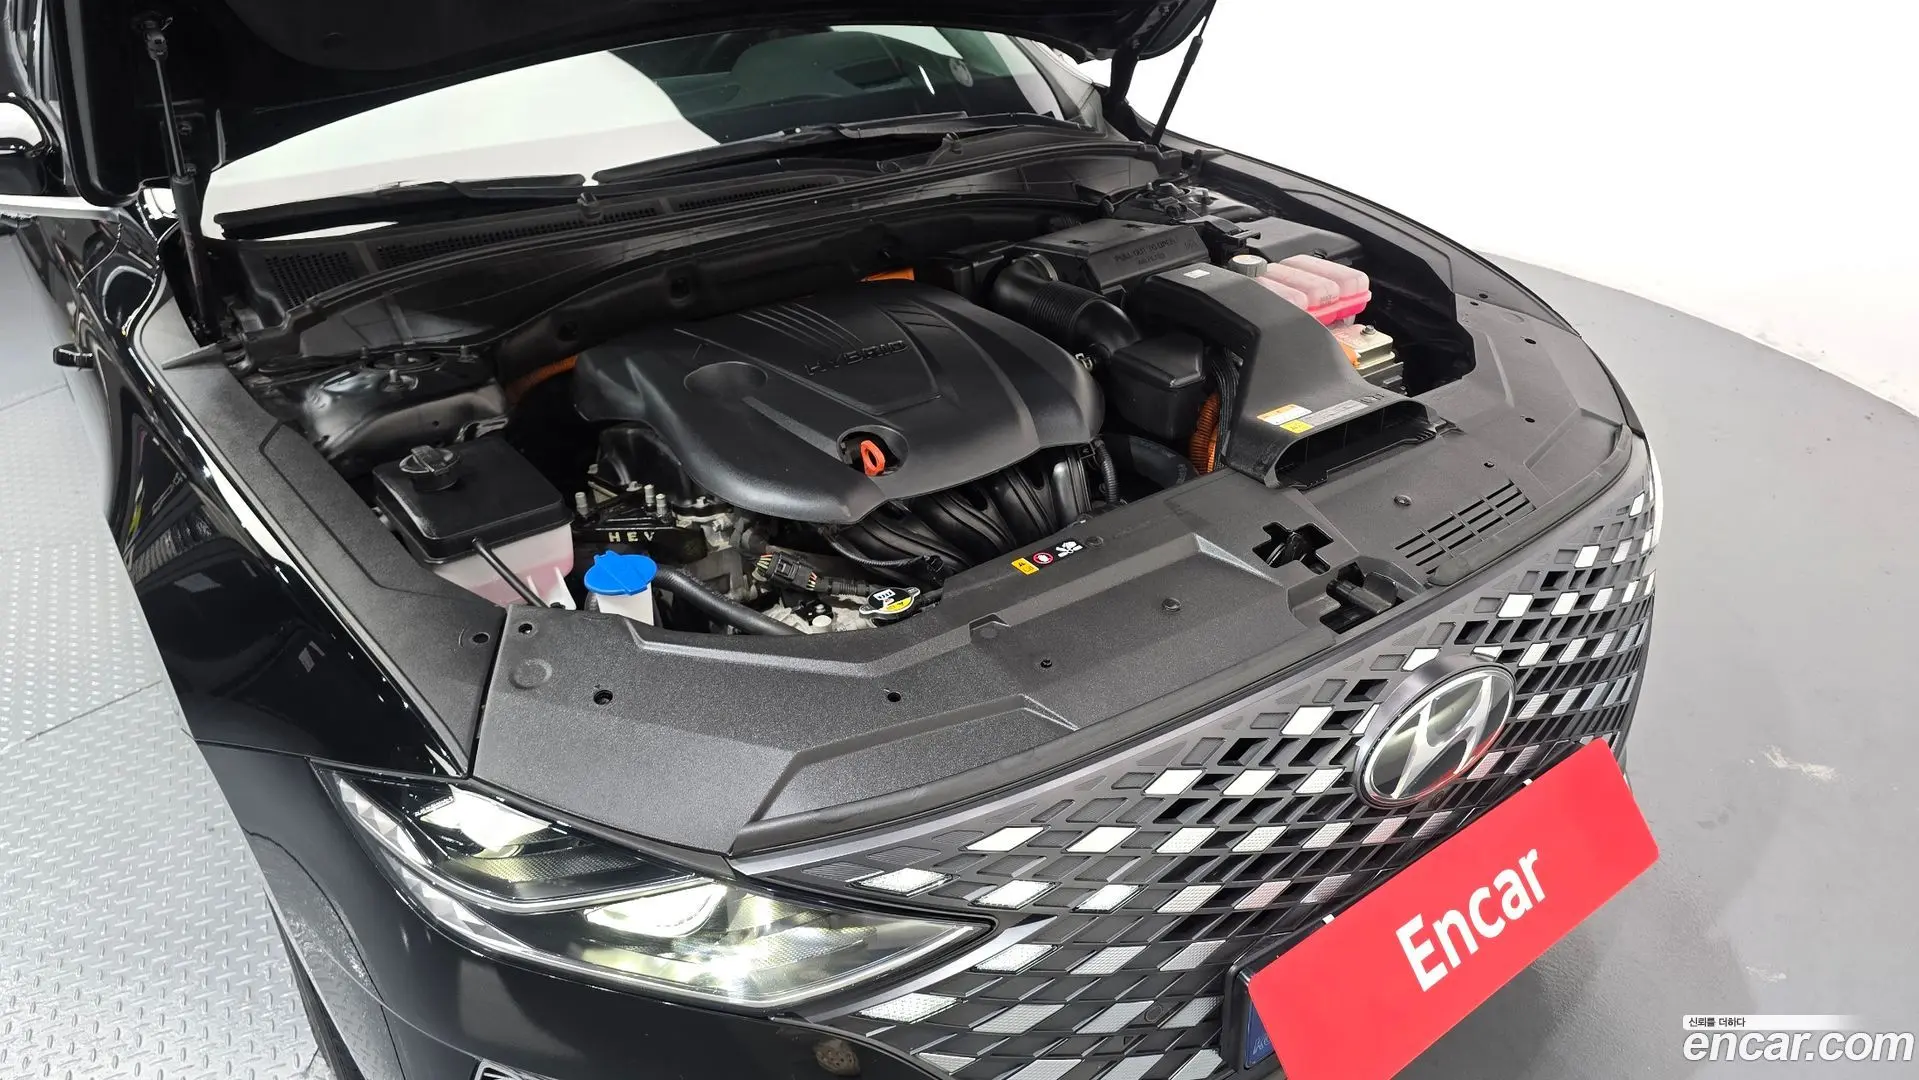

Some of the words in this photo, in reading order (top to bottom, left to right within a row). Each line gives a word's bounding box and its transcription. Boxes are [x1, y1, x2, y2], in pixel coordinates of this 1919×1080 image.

[804, 340, 907, 375] HYBRID
[608, 531, 655, 542] HEV
[1396, 848, 1546, 992] Encar
